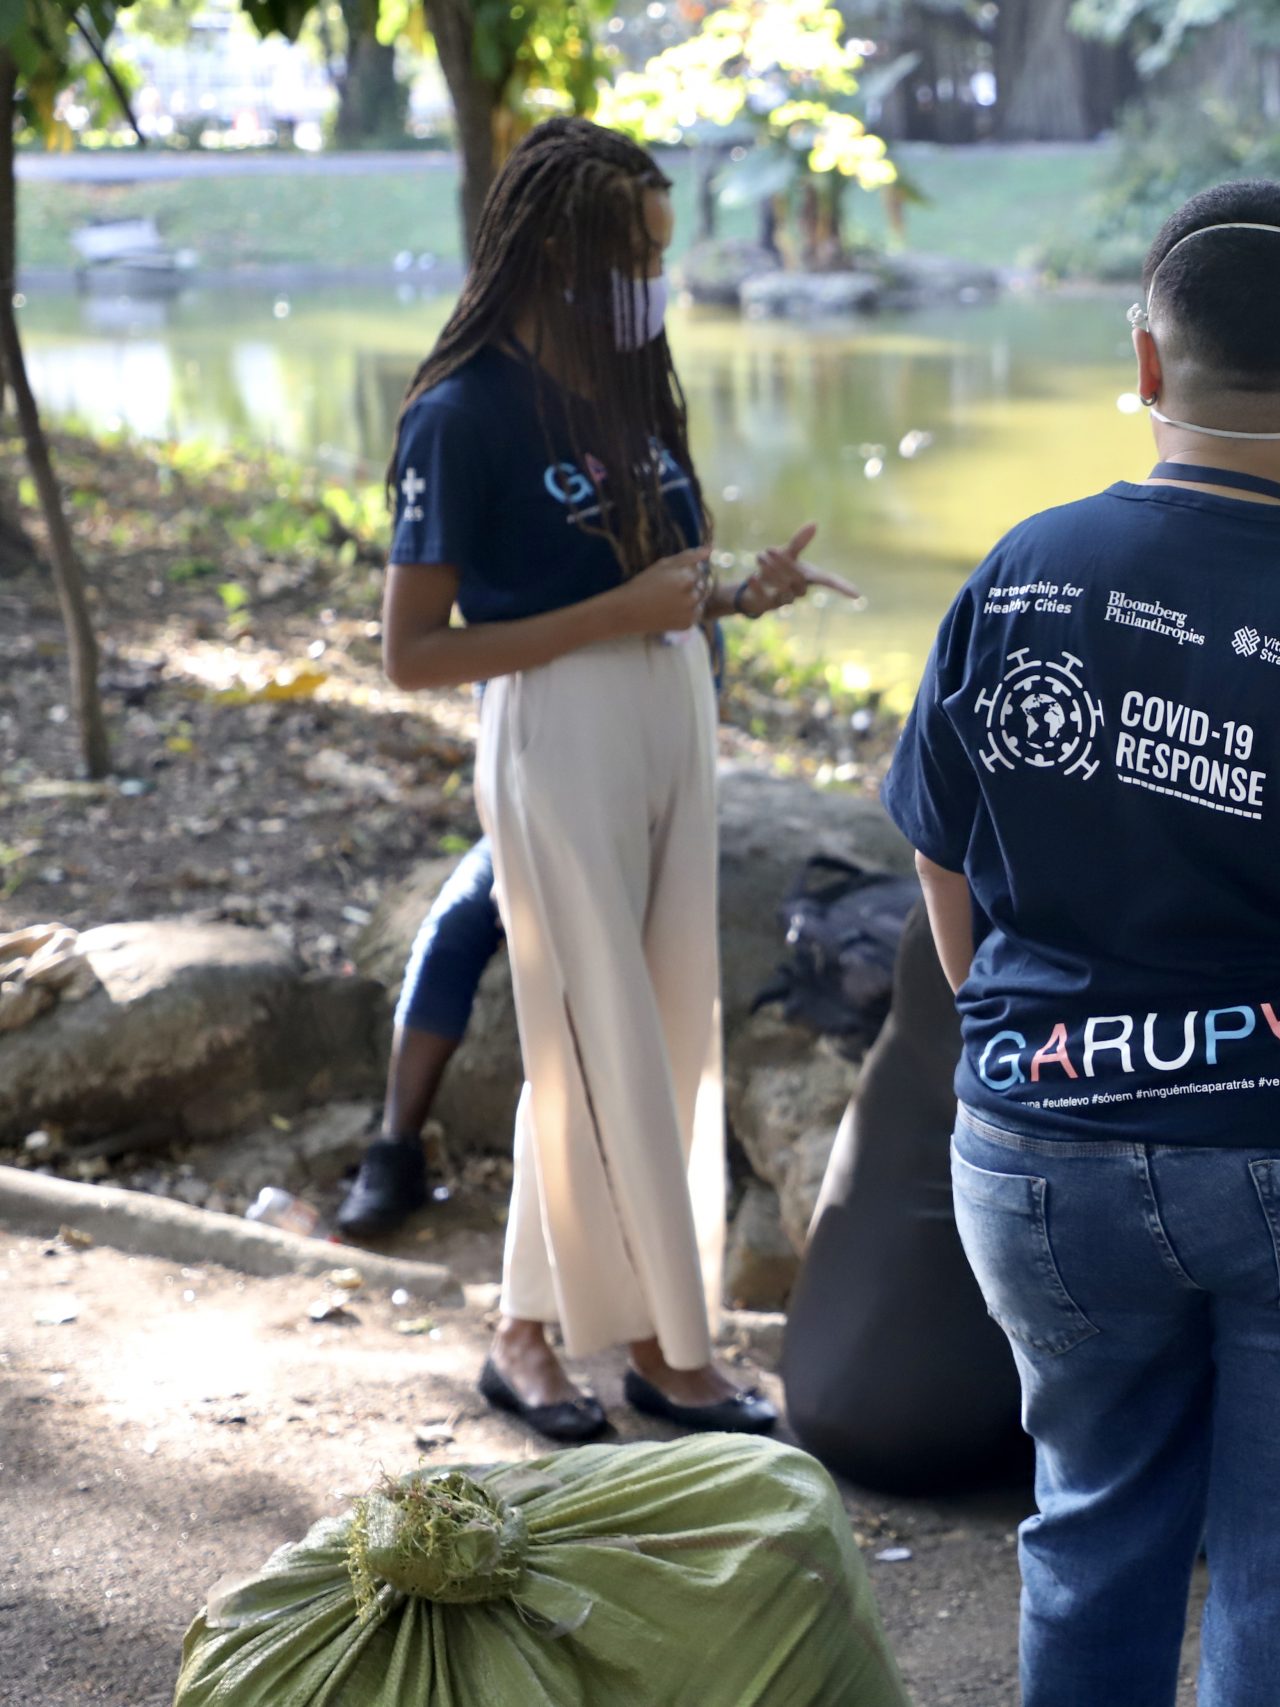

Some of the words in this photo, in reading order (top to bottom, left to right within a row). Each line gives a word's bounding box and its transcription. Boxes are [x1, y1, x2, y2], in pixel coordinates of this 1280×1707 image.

[983, 598, 1030, 614] Healthy
[1034, 599, 1072, 614] Cities
[988, 581, 1058, 599] Partnership
[1062, 583, 1083, 598] for
[1107, 590, 1187, 627] Bloomberg
[1104, 606, 1205, 645] Philanthropies
[1120, 690, 1254, 761] COVID-19
[1115, 731, 1266, 806] RESPONSE
[1042, 1096, 1090, 1109] #eutelevo
[1091, 1092, 1133, 1105] #sóvem
[1136, 1078, 1255, 1099] #ninguémficaparatrás
